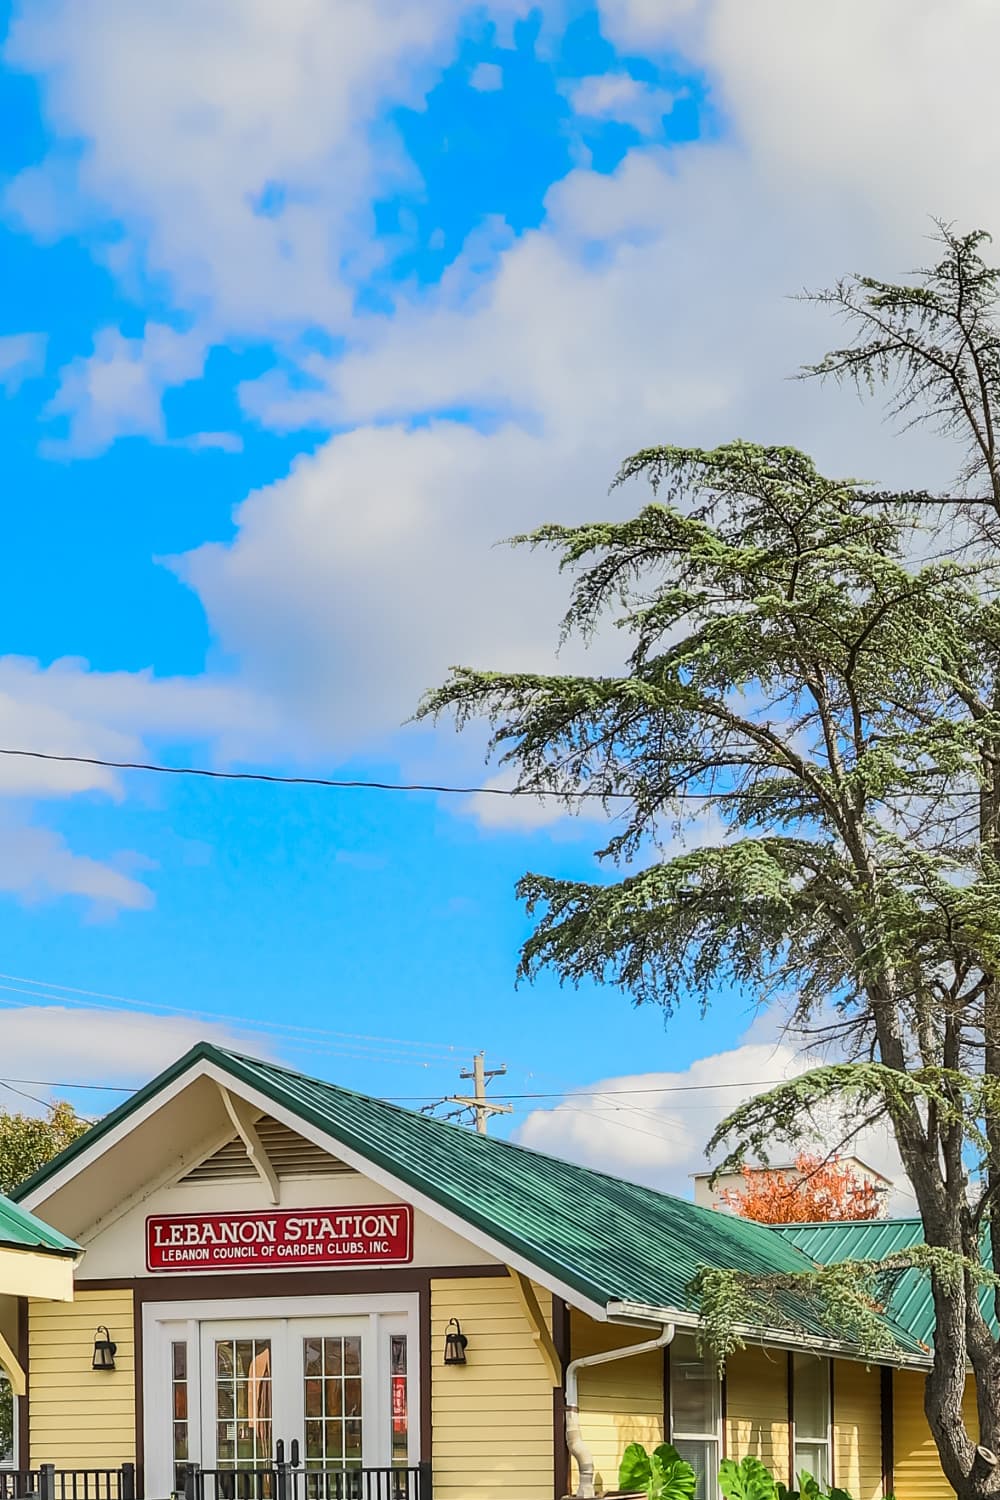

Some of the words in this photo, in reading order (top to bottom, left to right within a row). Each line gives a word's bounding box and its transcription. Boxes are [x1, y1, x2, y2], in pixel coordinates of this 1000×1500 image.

[154, 1220, 277, 1247] LEBANON
[284, 1215, 400, 1240] STATION
[161, 1249, 209, 1262] LEBANON
[213, 1246, 258, 1259] COUNCIL
[261, 1245, 275, 1257] OF
[277, 1243, 323, 1257] GARDEN
[327, 1242, 367, 1255] CLUBS,
[369, 1241, 392, 1253] INC.
